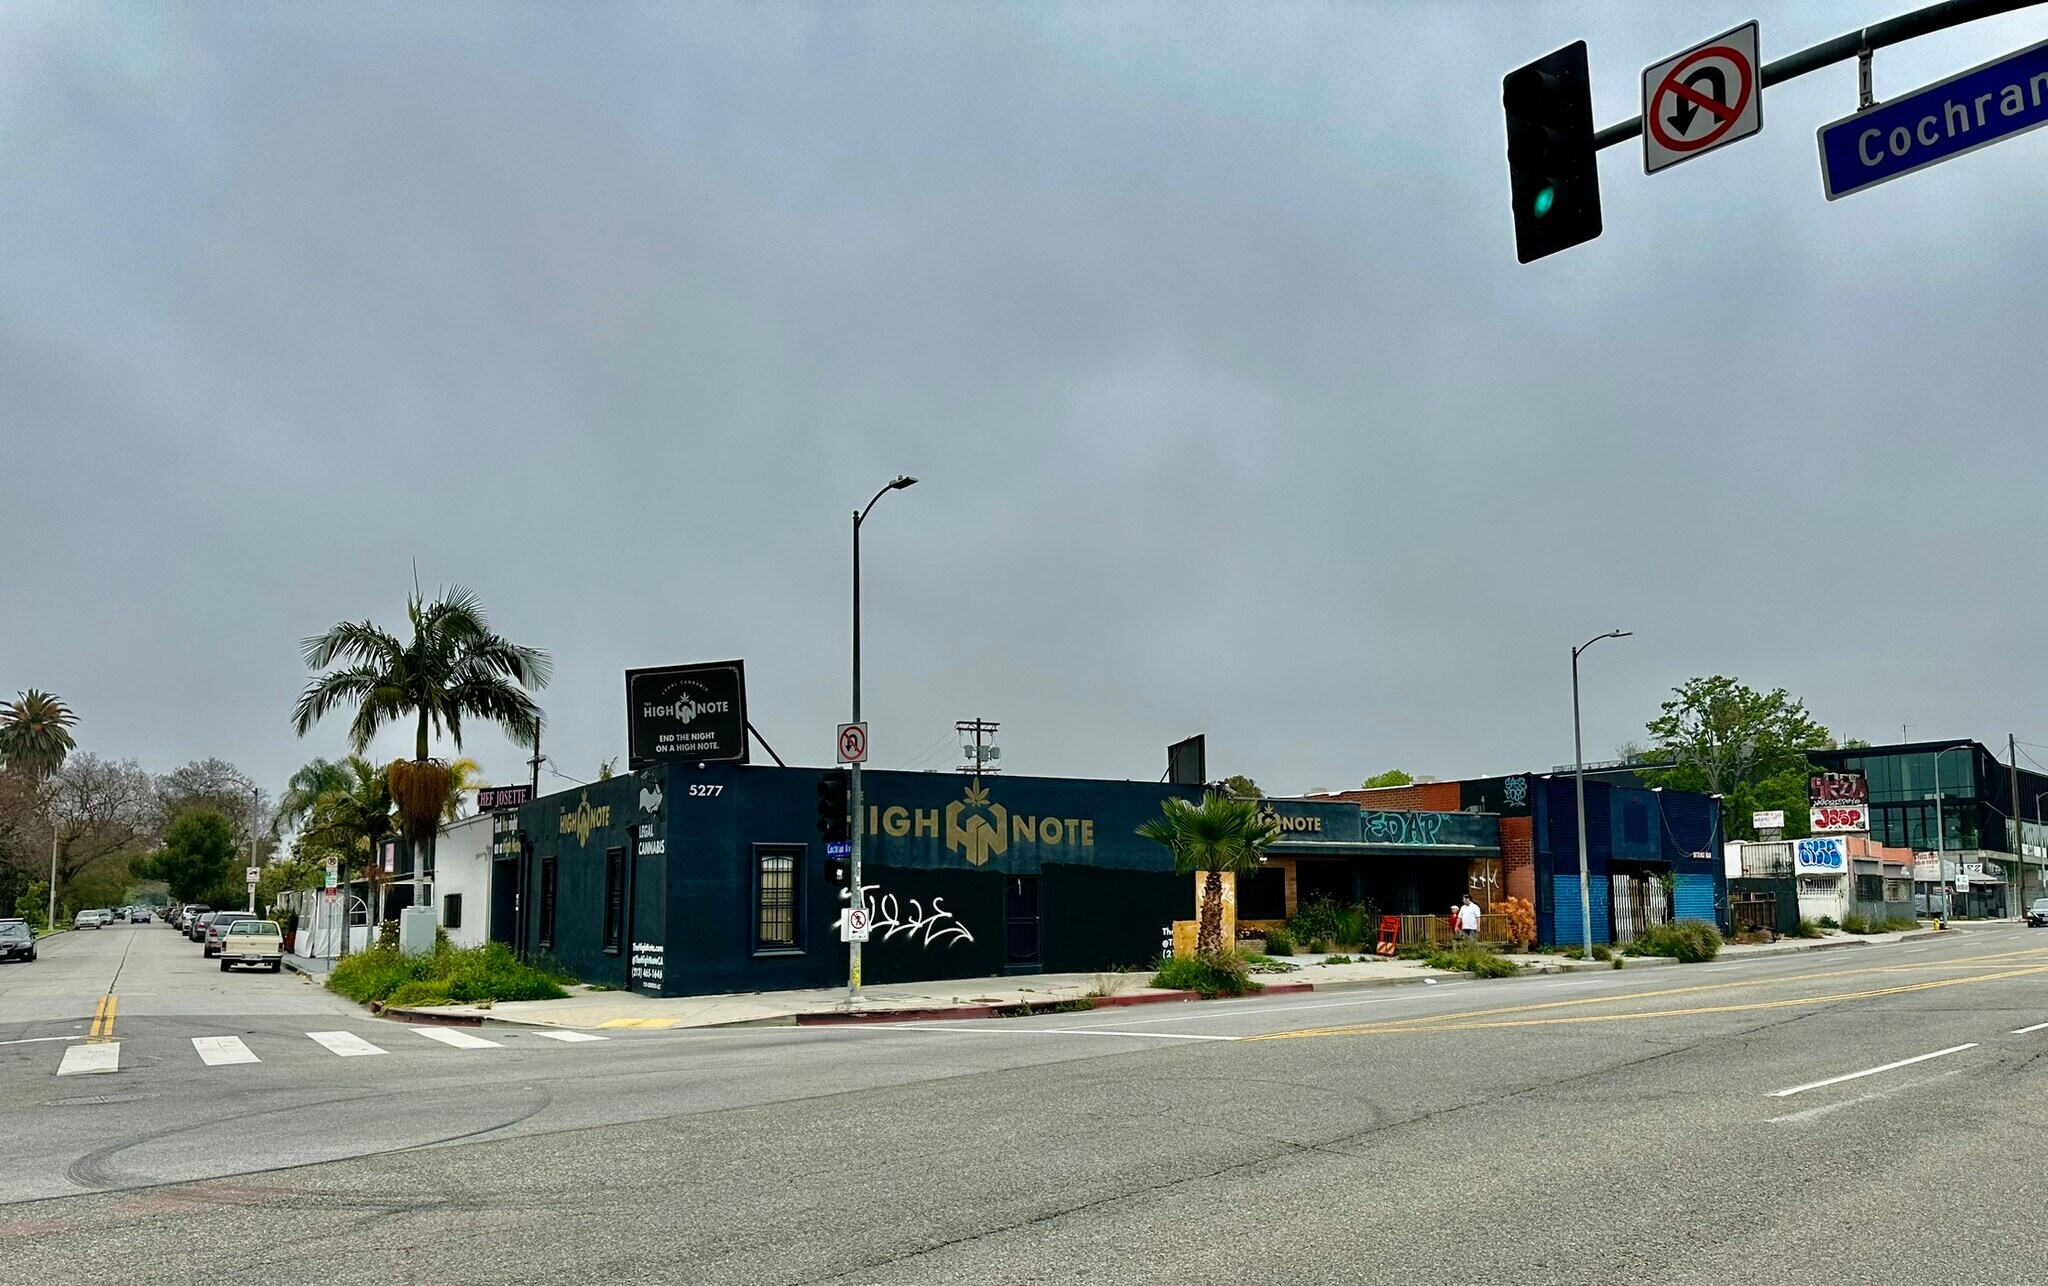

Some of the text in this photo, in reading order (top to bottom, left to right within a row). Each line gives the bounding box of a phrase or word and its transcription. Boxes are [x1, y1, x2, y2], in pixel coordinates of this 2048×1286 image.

[1858, 71, 2048, 167] Cochran
[643, 701, 729, 718] HIGH NOTE
[659, 731, 716, 743] END THE NIGHT
[655, 741, 720, 753] ON A HIGH NOTE.
[495, 788, 527, 808] JOSETTE
[689, 784, 724, 797] 5277
[559, 805, 610, 834] HIGH NOTE
[1282, 816, 1322, 832] NOTE
[638, 824, 654, 838] LEGAL
[1012, 814, 1094, 846] NOTE
[638, 839, 665, 856] CANNABIS
[827, 844, 844, 855] Cochran
